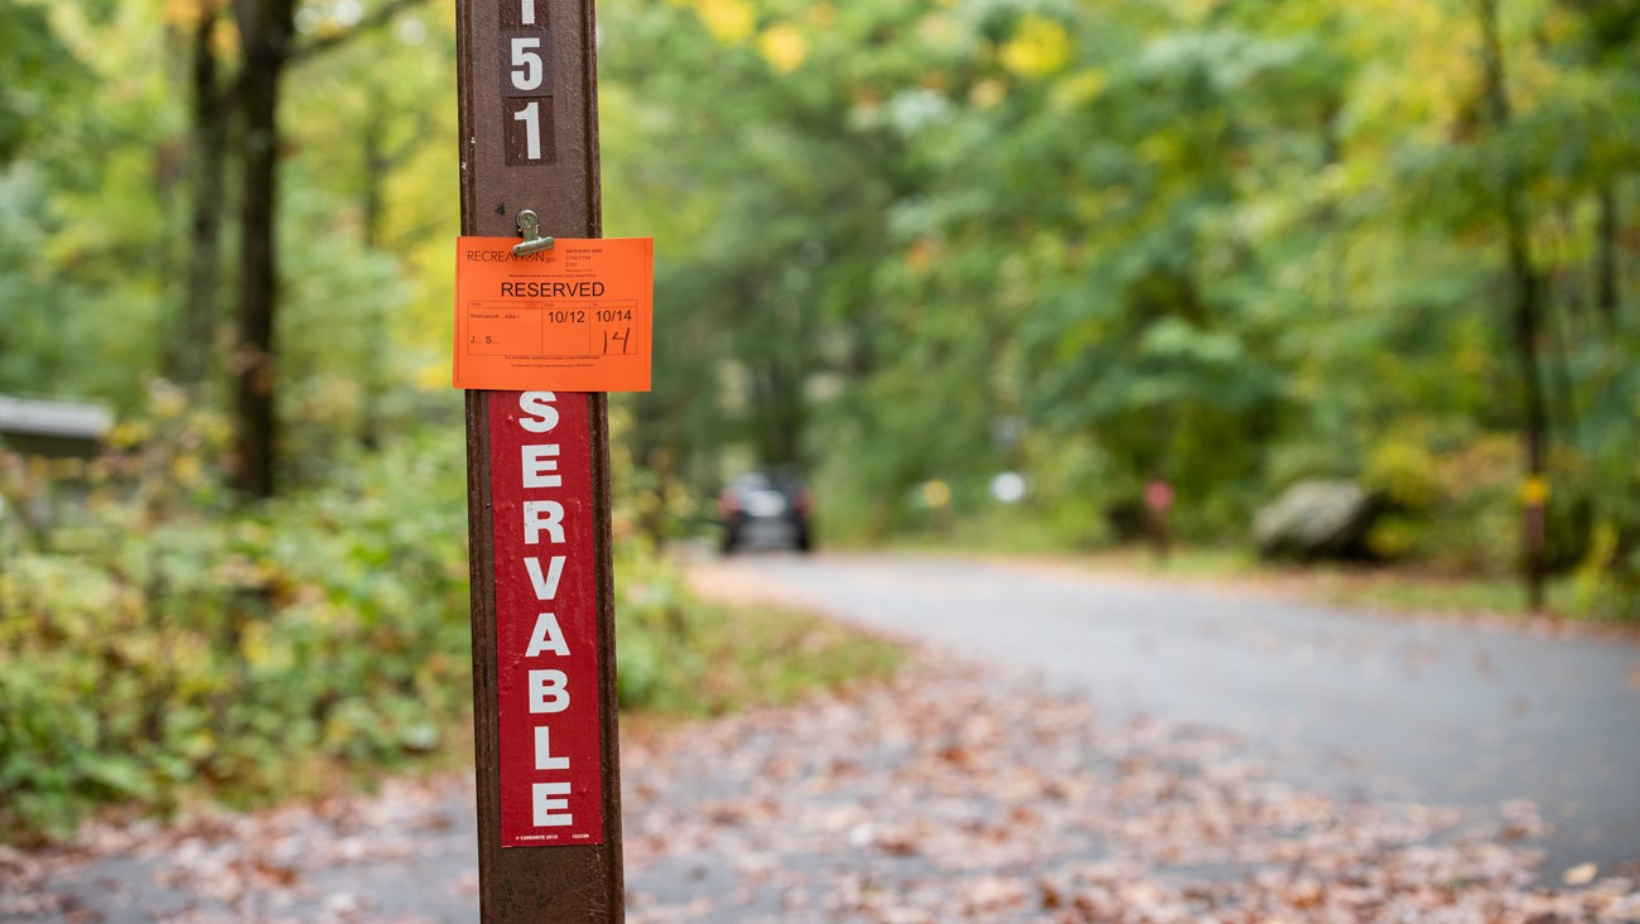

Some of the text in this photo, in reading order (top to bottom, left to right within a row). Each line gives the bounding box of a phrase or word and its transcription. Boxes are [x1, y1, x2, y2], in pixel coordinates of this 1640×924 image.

[501, 281, 605, 297] RESERVED
[548, 310, 585, 323] 10/12
[596, 309, 632, 322] 10/14
